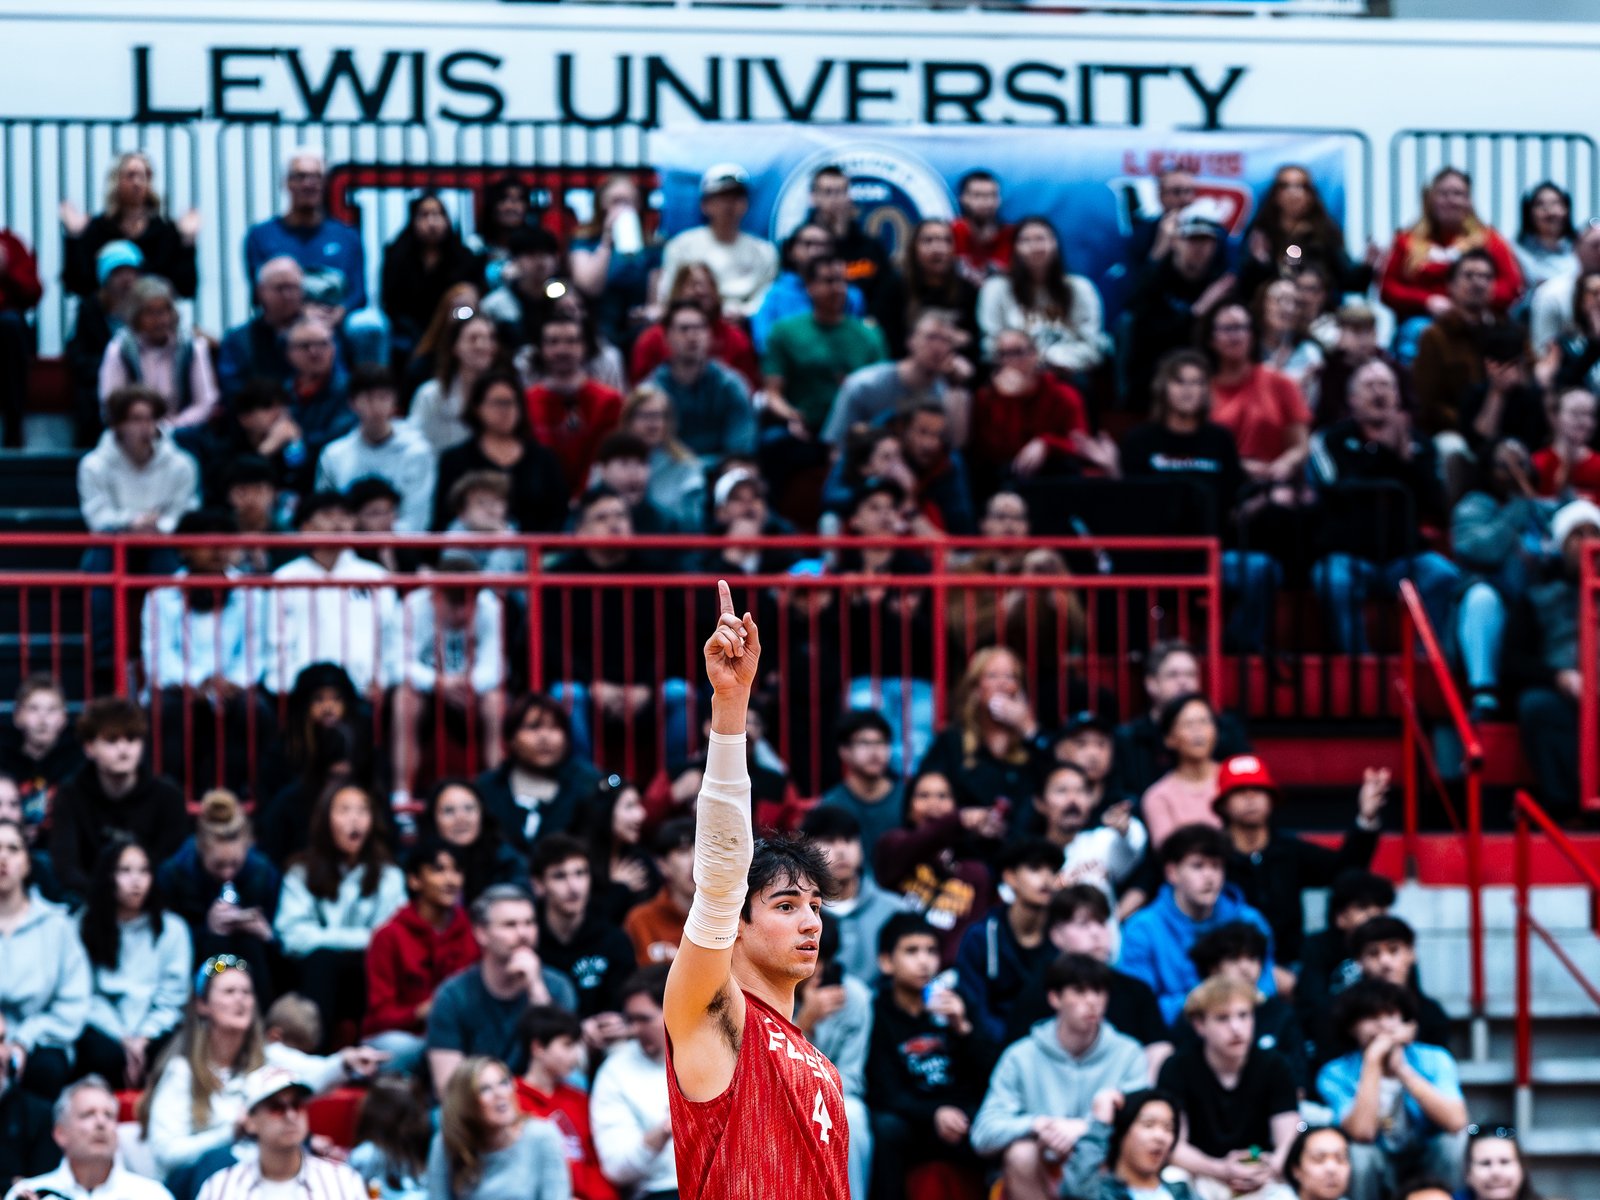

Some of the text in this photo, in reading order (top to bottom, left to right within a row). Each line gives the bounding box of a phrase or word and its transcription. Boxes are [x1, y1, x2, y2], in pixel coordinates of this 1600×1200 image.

[134, 46, 1248, 130] LEWIS UNIVERSITY
[811, 1087, 833, 1145] 4
